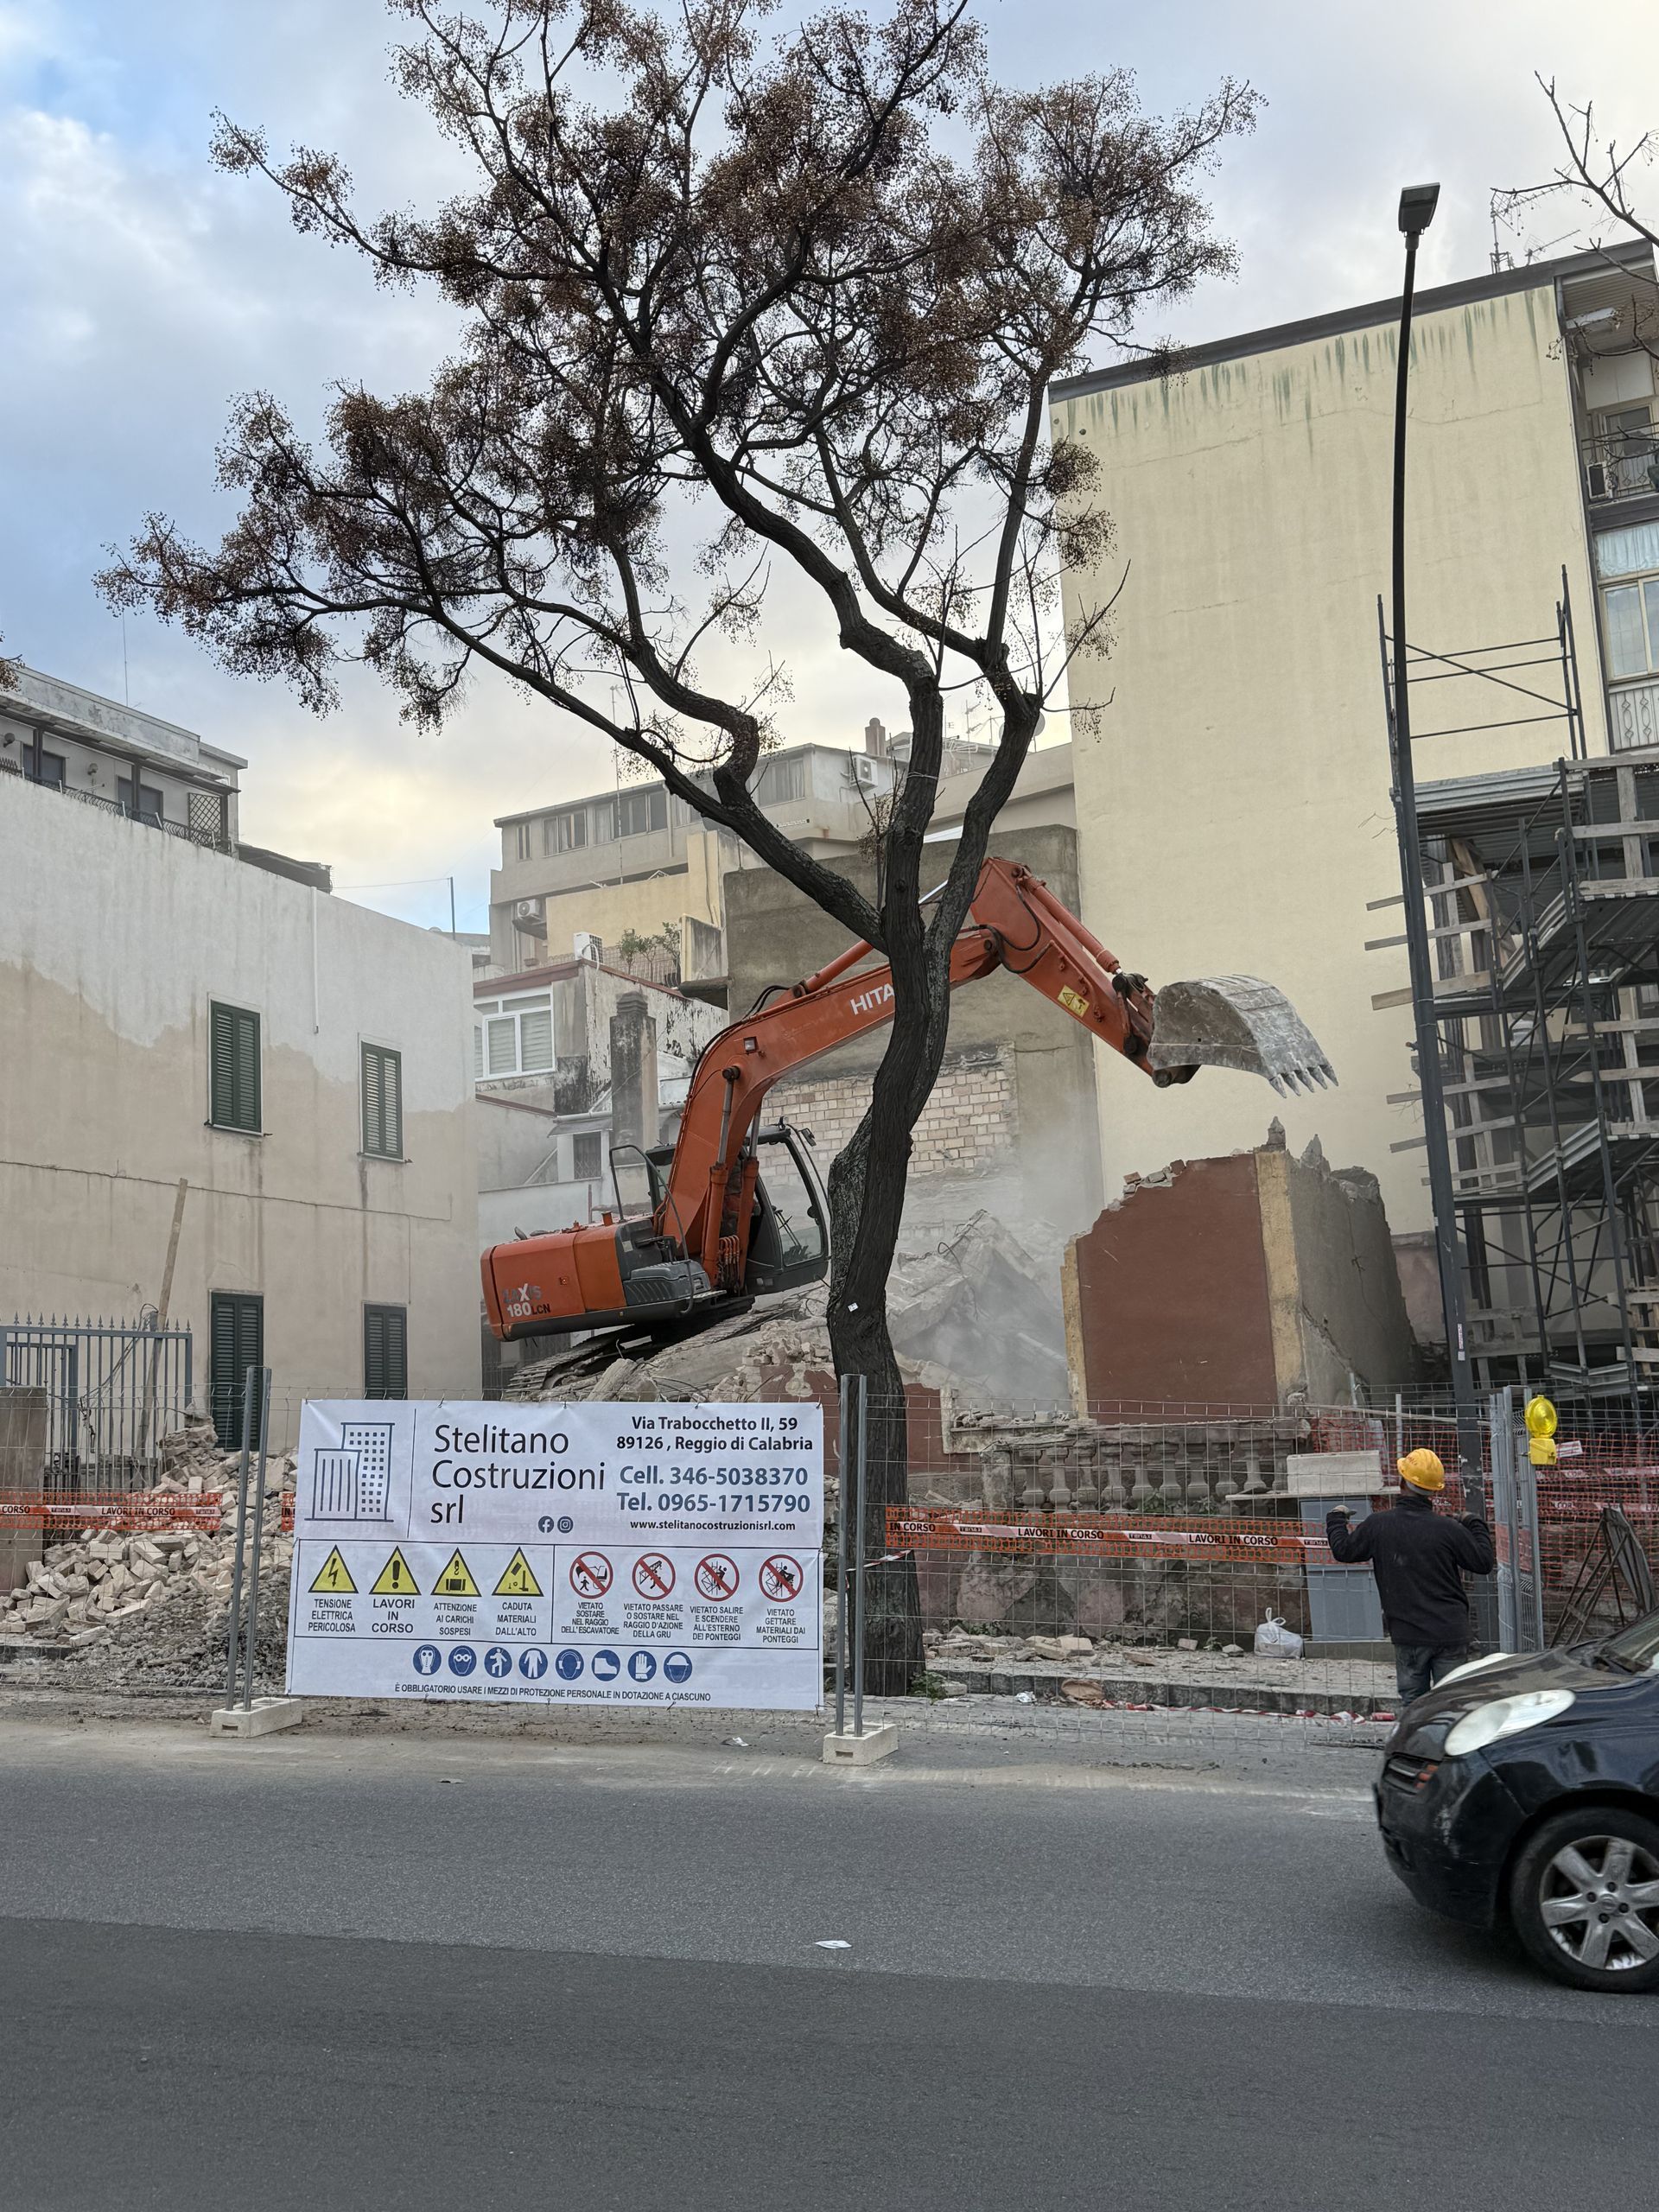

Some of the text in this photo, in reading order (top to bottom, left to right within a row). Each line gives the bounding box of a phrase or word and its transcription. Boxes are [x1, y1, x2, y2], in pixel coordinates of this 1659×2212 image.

[849, 983, 895, 1015] HITA
[632, 1416, 655, 1430] Via
[658, 1416, 757, 1431] Trabocchetto
[779, 1417, 798, 1431] 59
[434, 1424, 569, 1454] Stelitano
[616, 1436, 664, 1450] 89126
[675, 1436, 727, 1453] Reggio
[730, 1437, 745, 1451] di
[748, 1437, 813, 1451] Calabria
[432, 1459, 605, 1490] Costruzioni
[620, 1465, 808, 1485] Cell. 346-5038370
[616, 1492, 810, 1513] Tel. 0965-1715790
[2, 1505, 30, 1514] CORSO
[101, 1507, 131, 1516] LAVORI
[132, 1507, 144, 1516] IN
[147, 1507, 175, 1516] CORSO
[430, 1494, 464, 1523] srl
[630, 1519, 796, 1530] www.stelitanocostruzionisrl.com
[890, 1522, 900, 1531] IN
[903, 1522, 936, 1532] CORSO
[1018, 1528, 1054, 1538] LAVORI
[1056, 1529, 1068, 1538] IN
[1071, 1529, 1104, 1540] CORSO
[1189, 1534, 1226, 1544] LAVORI
[1229, 1535, 1241, 1544] IN
[1243, 1535, 1278, 1546] CORSO
[315, 1599, 352, 1609] TENSIONE
[372, 1599, 415, 1609] LAVORI
[434, 1603, 477, 1612] ATTENZIONE
[502, 1602, 532, 1611] CADUTA
[311, 1611, 353, 1620] ELETTRICA
[387, 1611, 398, 1620] IN
[445, 1615, 474, 1624] CARICHI
[497, 1615, 536, 1624] MATERIALI
[308, 1622, 356, 1632] PERICOLOSA
[372, 1623, 414, 1633] CORSO
[652, 1621, 683, 1630] D'AZIONE
[439, 1627, 471, 1636] SOSPESI
[495, 1627, 537, 1636] DALL'ALTO
[395, 1682, 400, 1692] È
[402, 1684, 456, 1694] OBBLIGATORIO
[457, 1686, 482, 1694] USARE
[487, 1687, 509, 1695] MEZZI
[519, 1688, 566, 1698] PROTEZIONE
[567, 1690, 612, 1699] PERSONALE
[622, 1691, 664, 1700] DOTAZIONE
[664, 1692, 671, 1700] A
[672, 1692, 711, 1701] CIASCUNO
